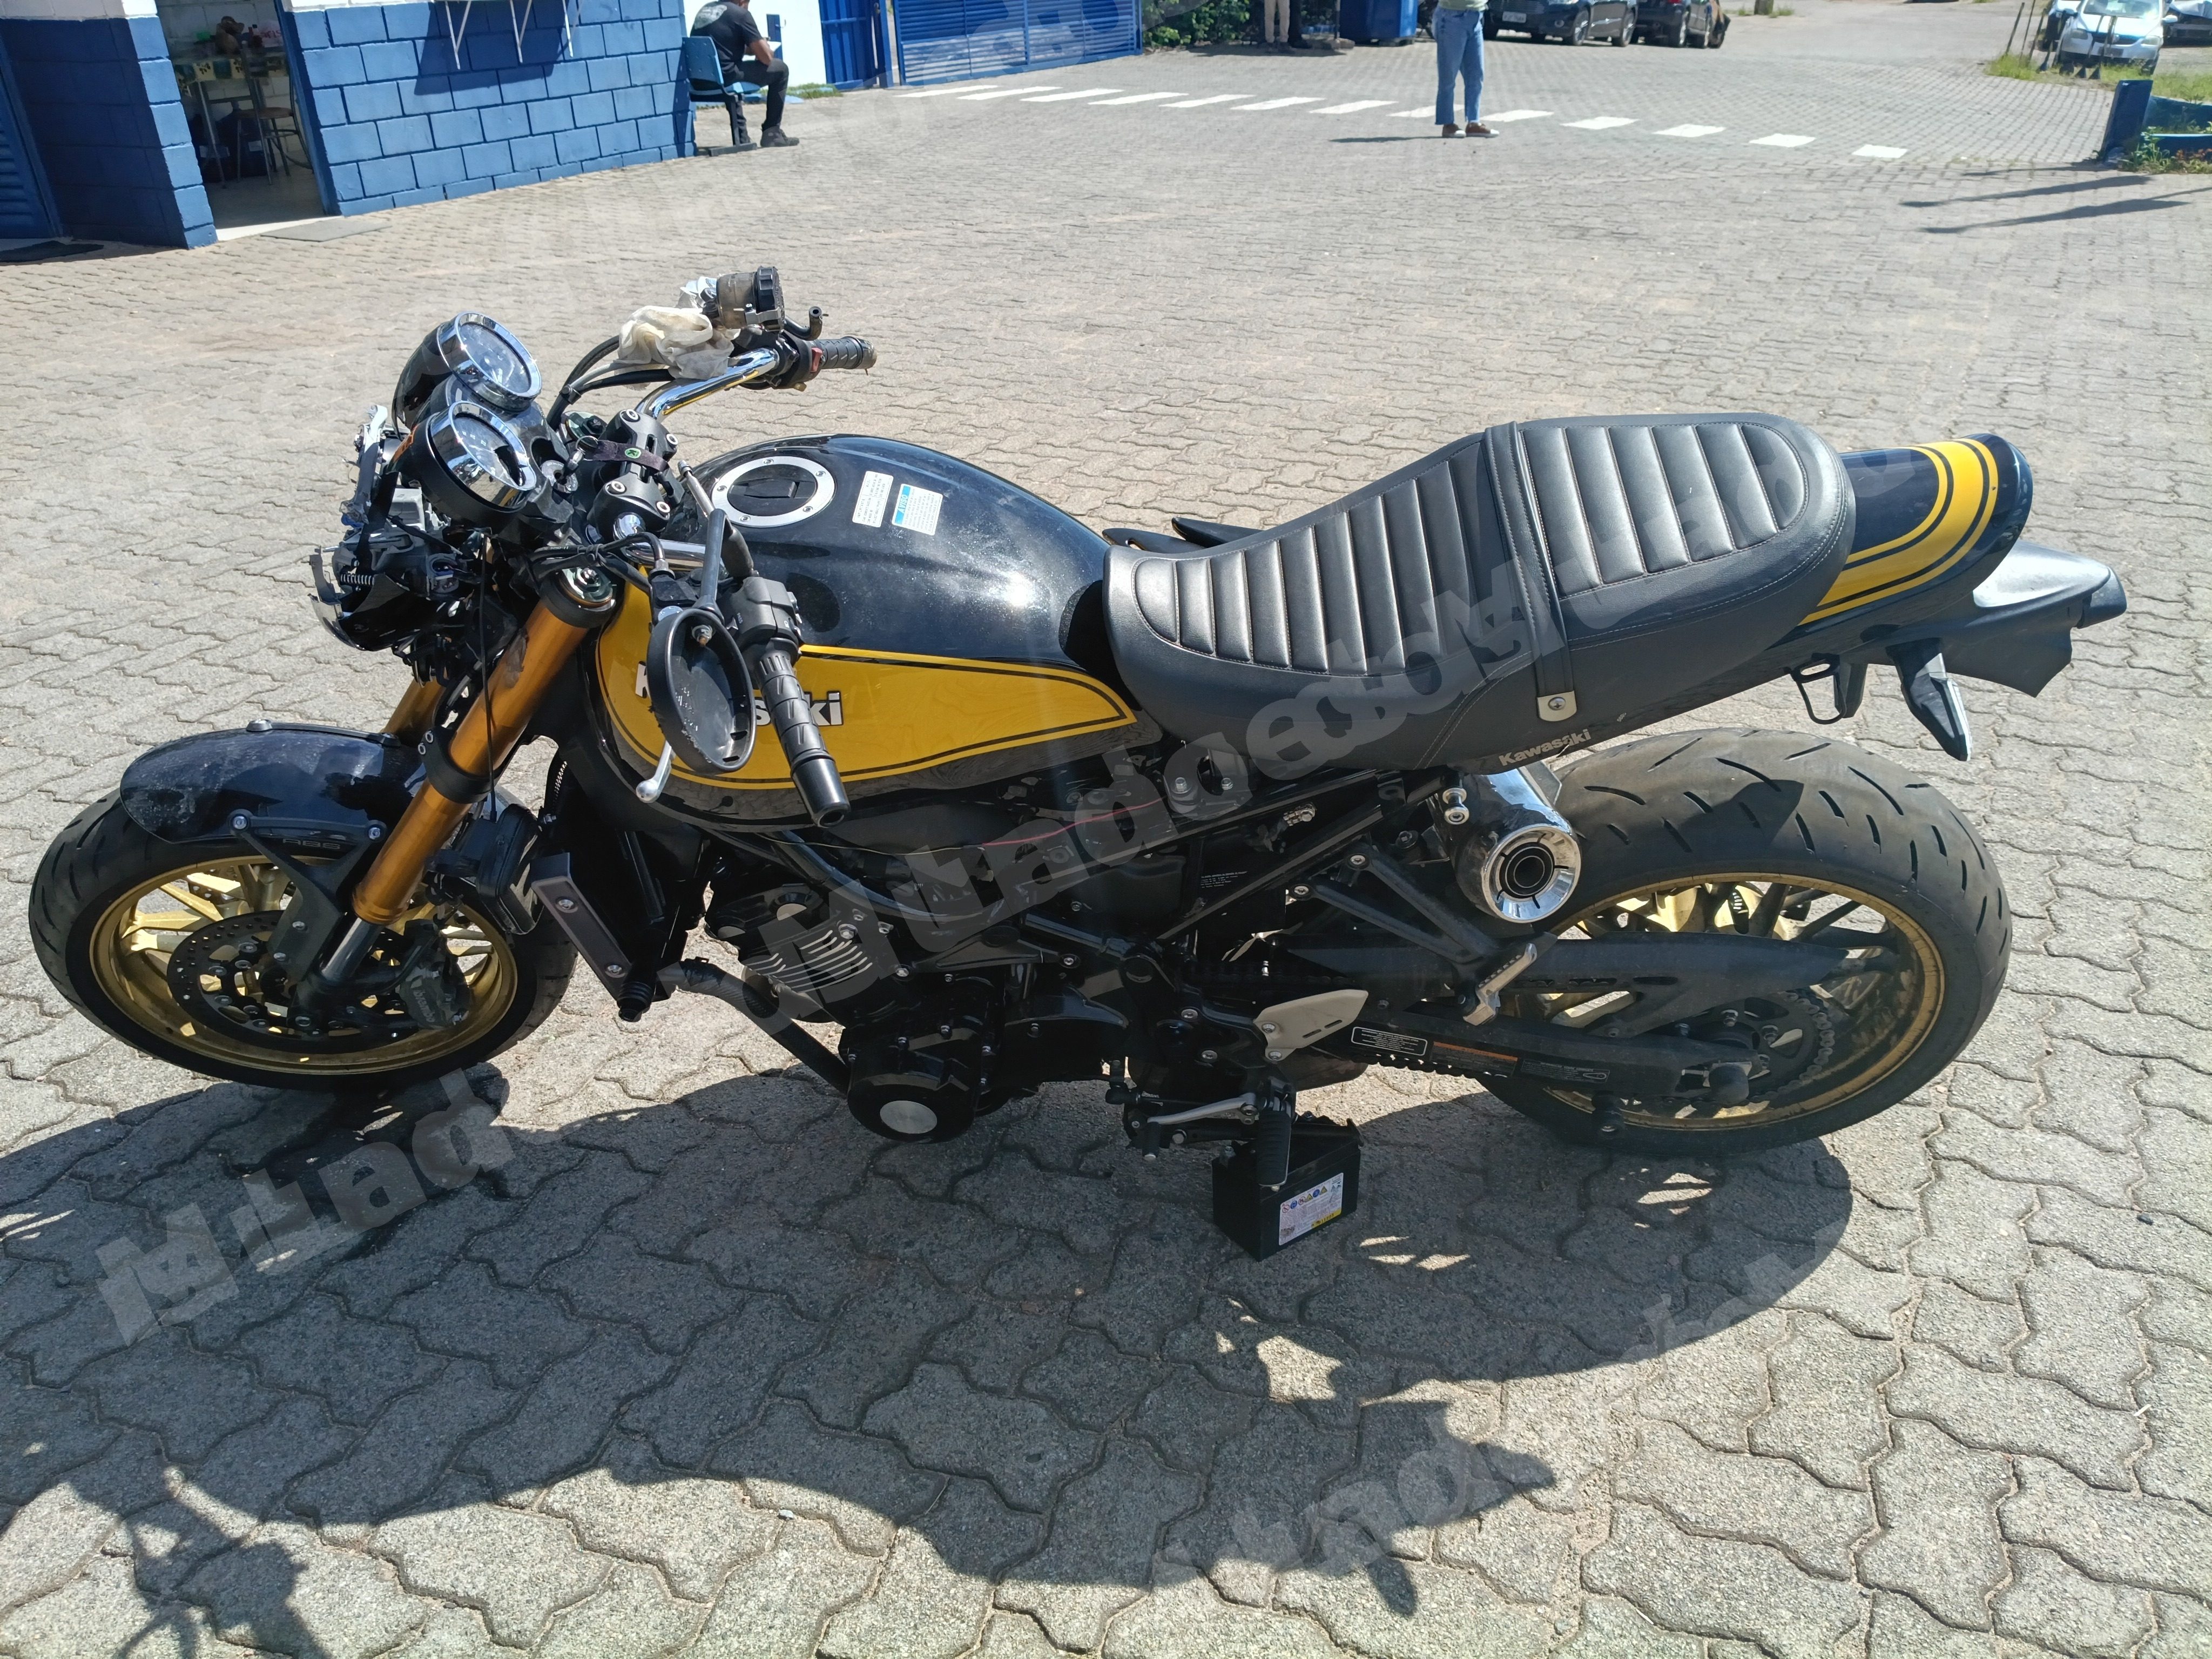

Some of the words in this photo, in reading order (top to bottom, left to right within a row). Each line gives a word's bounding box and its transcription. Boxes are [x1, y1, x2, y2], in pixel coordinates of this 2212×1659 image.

[898, 494, 908, 514] AVISO
[1499, 729, 1591, 766] Kawasaki
[282, 838, 341, 849] ABS
[413, 990, 436, 1023] brembo
